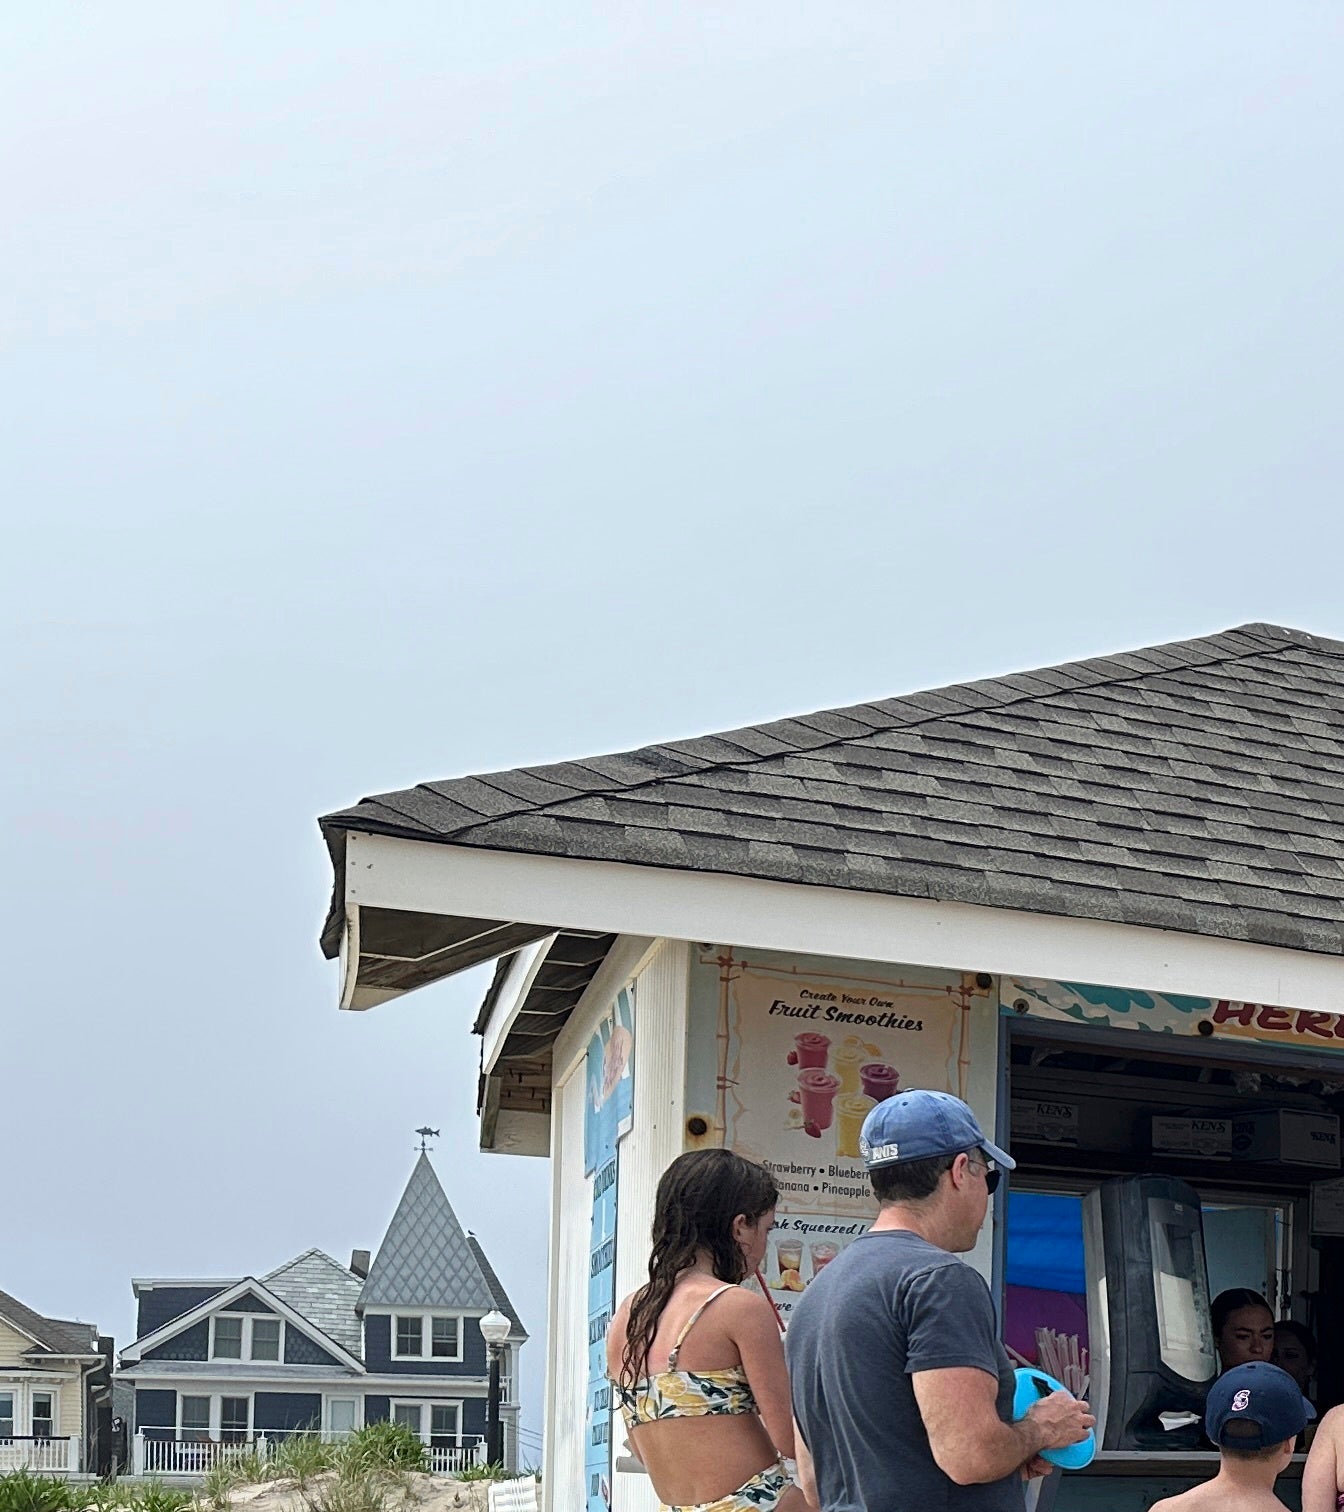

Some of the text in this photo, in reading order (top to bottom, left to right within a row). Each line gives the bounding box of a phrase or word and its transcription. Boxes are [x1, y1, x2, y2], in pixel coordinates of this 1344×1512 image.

[800, 990, 894, 1008] Create Your Own
[768, 1000, 923, 1032] Fruit Smoothies
[762, 1160, 870, 1179] Strawberry Blueberr
[776, 1182, 871, 1198] anana Pineapple
[792, 1220, 859, 1235] Squeezed
